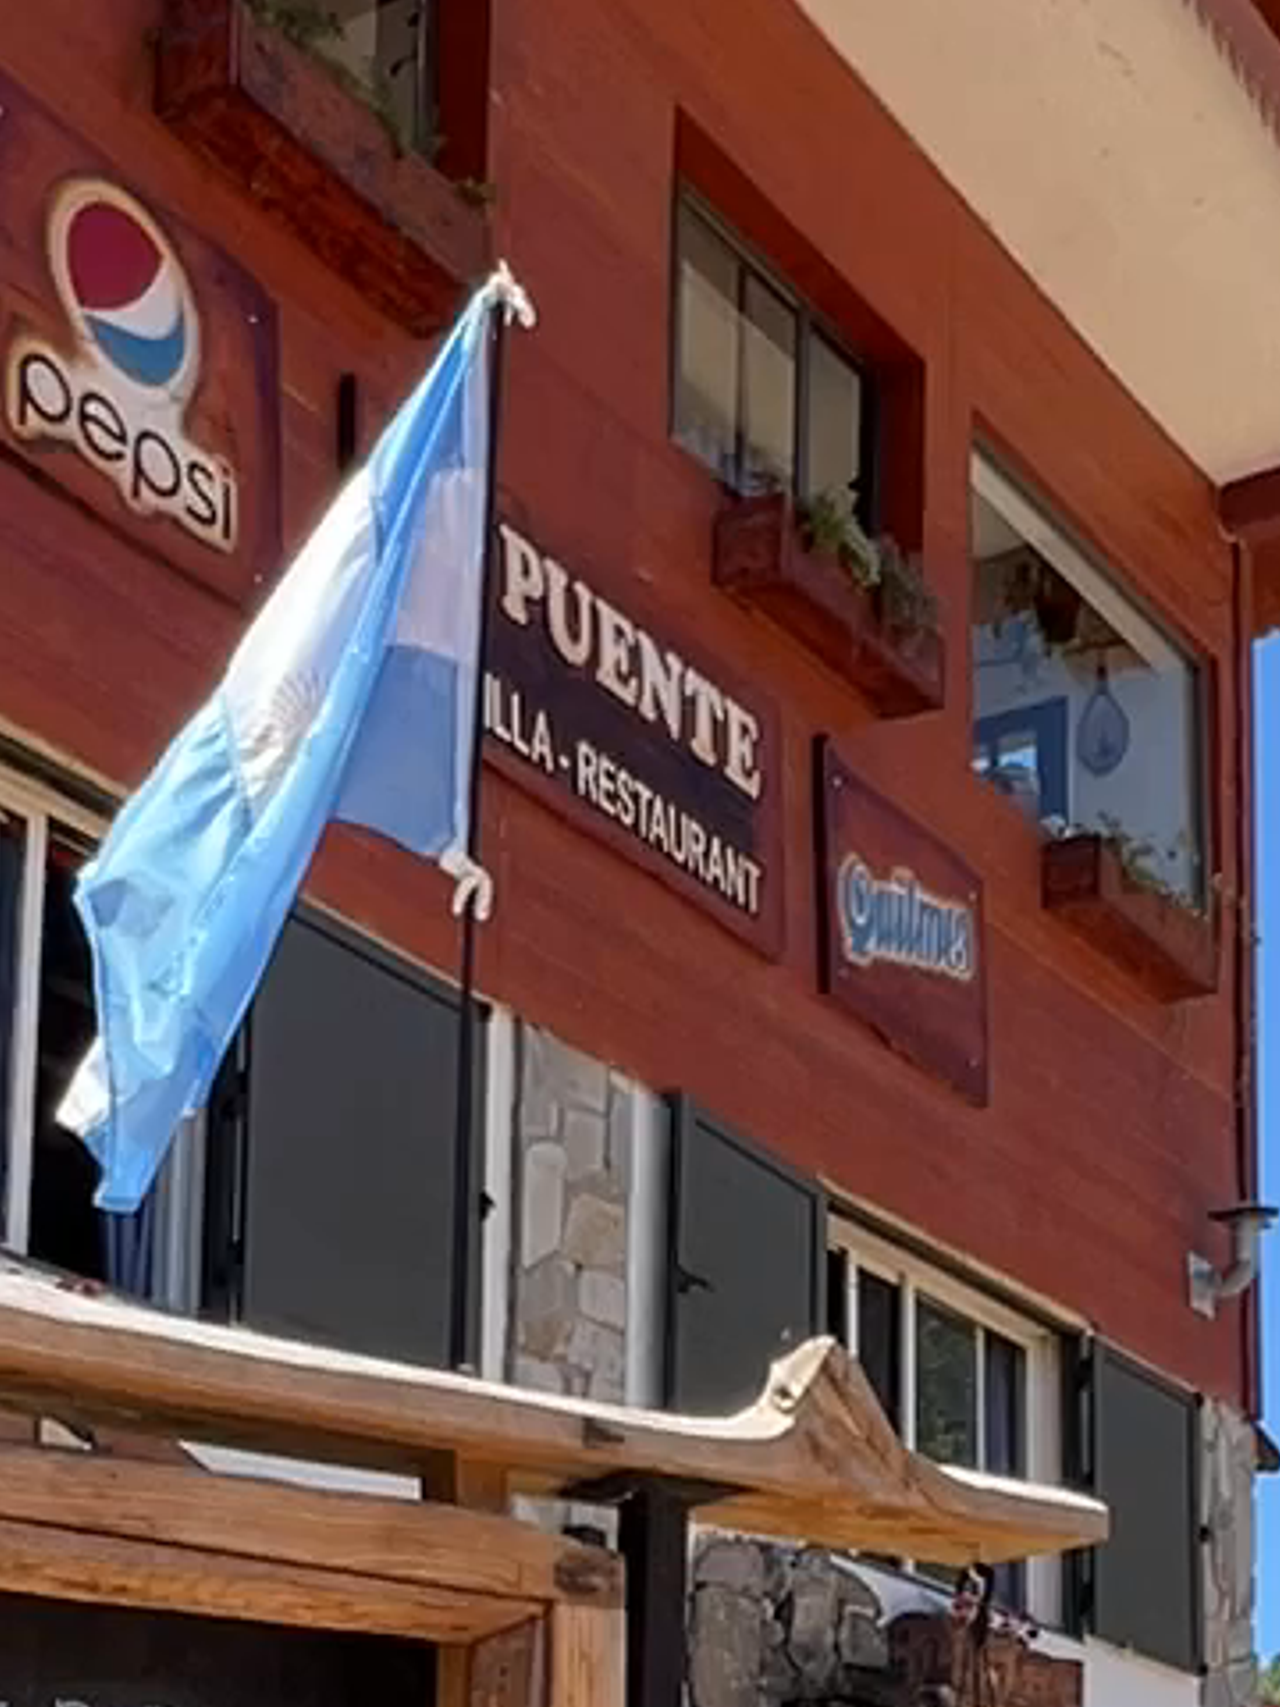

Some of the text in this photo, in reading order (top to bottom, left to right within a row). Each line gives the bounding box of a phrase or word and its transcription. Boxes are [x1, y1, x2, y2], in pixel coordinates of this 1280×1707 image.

[18, 353, 233, 540] pepsi
[500, 523, 762, 799] PUENTE
[484, 673, 554, 773] ILLA
[577, 742, 761, 914] RESTAURANT
